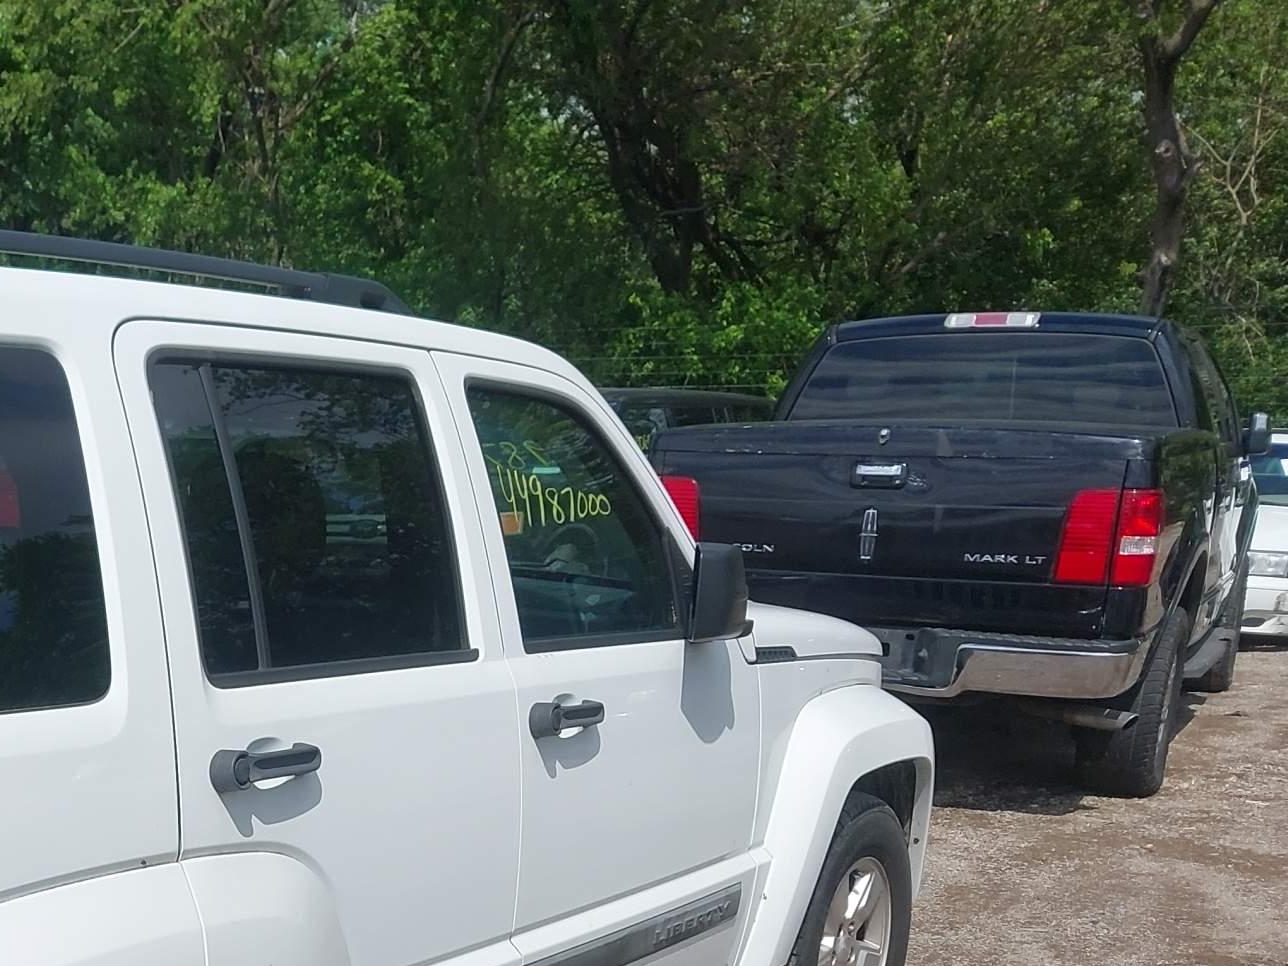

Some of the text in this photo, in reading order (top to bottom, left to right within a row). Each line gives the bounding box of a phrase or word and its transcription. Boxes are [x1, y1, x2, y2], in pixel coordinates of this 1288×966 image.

[497, 465, 611, 527] 44987000
[963, 553, 1047, 565] MARK LT
[653, 900, 731, 945] LIBERTY
